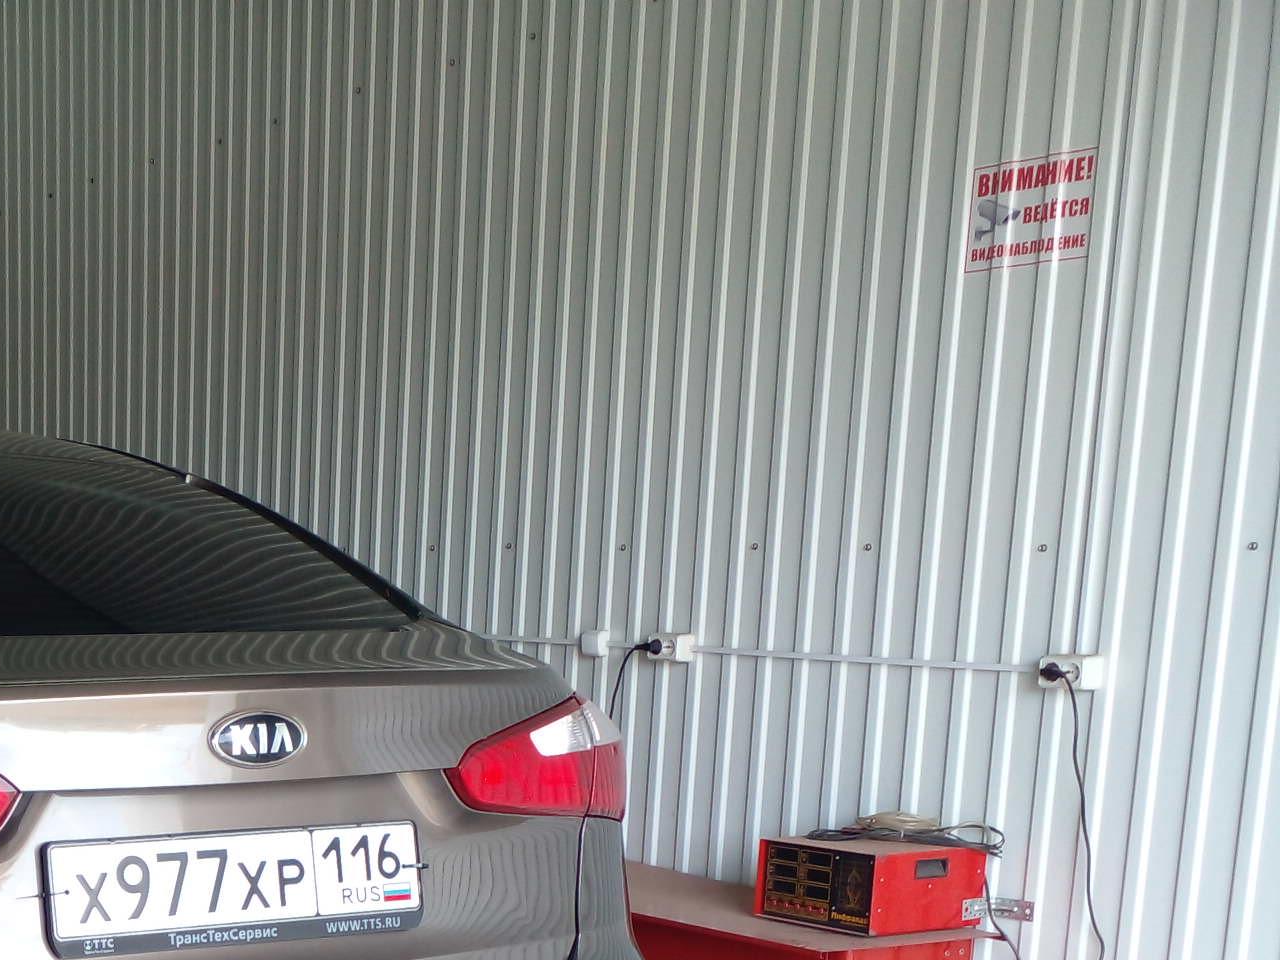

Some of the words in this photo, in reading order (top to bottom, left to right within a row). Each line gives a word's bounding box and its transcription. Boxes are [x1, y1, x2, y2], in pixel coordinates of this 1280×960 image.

[977, 155, 1095, 197] ВНИМАНИЕ!
[1022, 197, 1090, 225] ВЕДЁТСЯ
[229, 722, 294, 756] KIA
[322, 833, 402, 884] 116
[342, 885, 381, 904] RUS
[168, 927, 278, 949] ТрансТехСервис
[326, 916, 401, 934] WWW.TTS.RU
